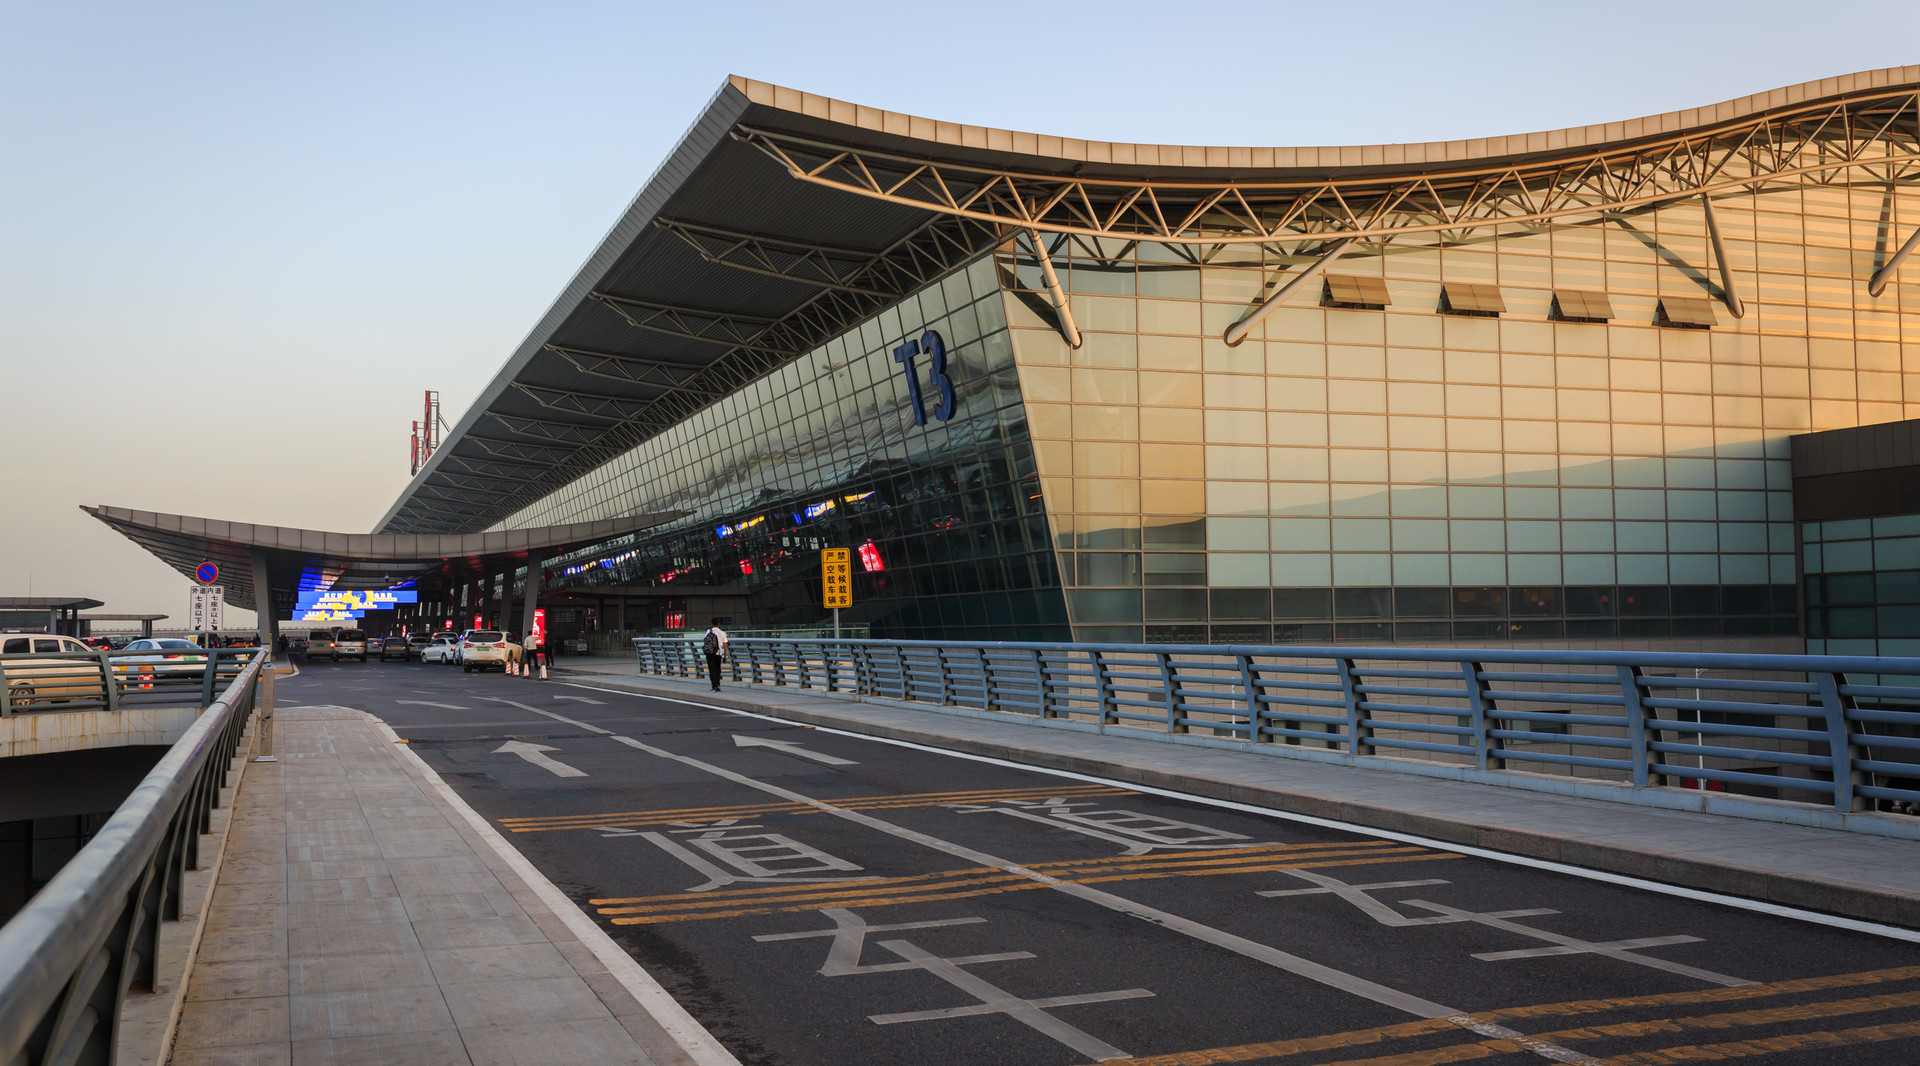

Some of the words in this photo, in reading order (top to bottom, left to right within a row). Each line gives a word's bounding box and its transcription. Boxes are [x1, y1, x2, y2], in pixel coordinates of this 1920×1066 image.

[893, 330, 957, 426] T3
[826, 552, 846, 561] 严禁
[827, 565, 837, 604] 空载车辆
[838, 564, 847, 604] 等候载客
[195, 595, 203, 624] 七座以下
